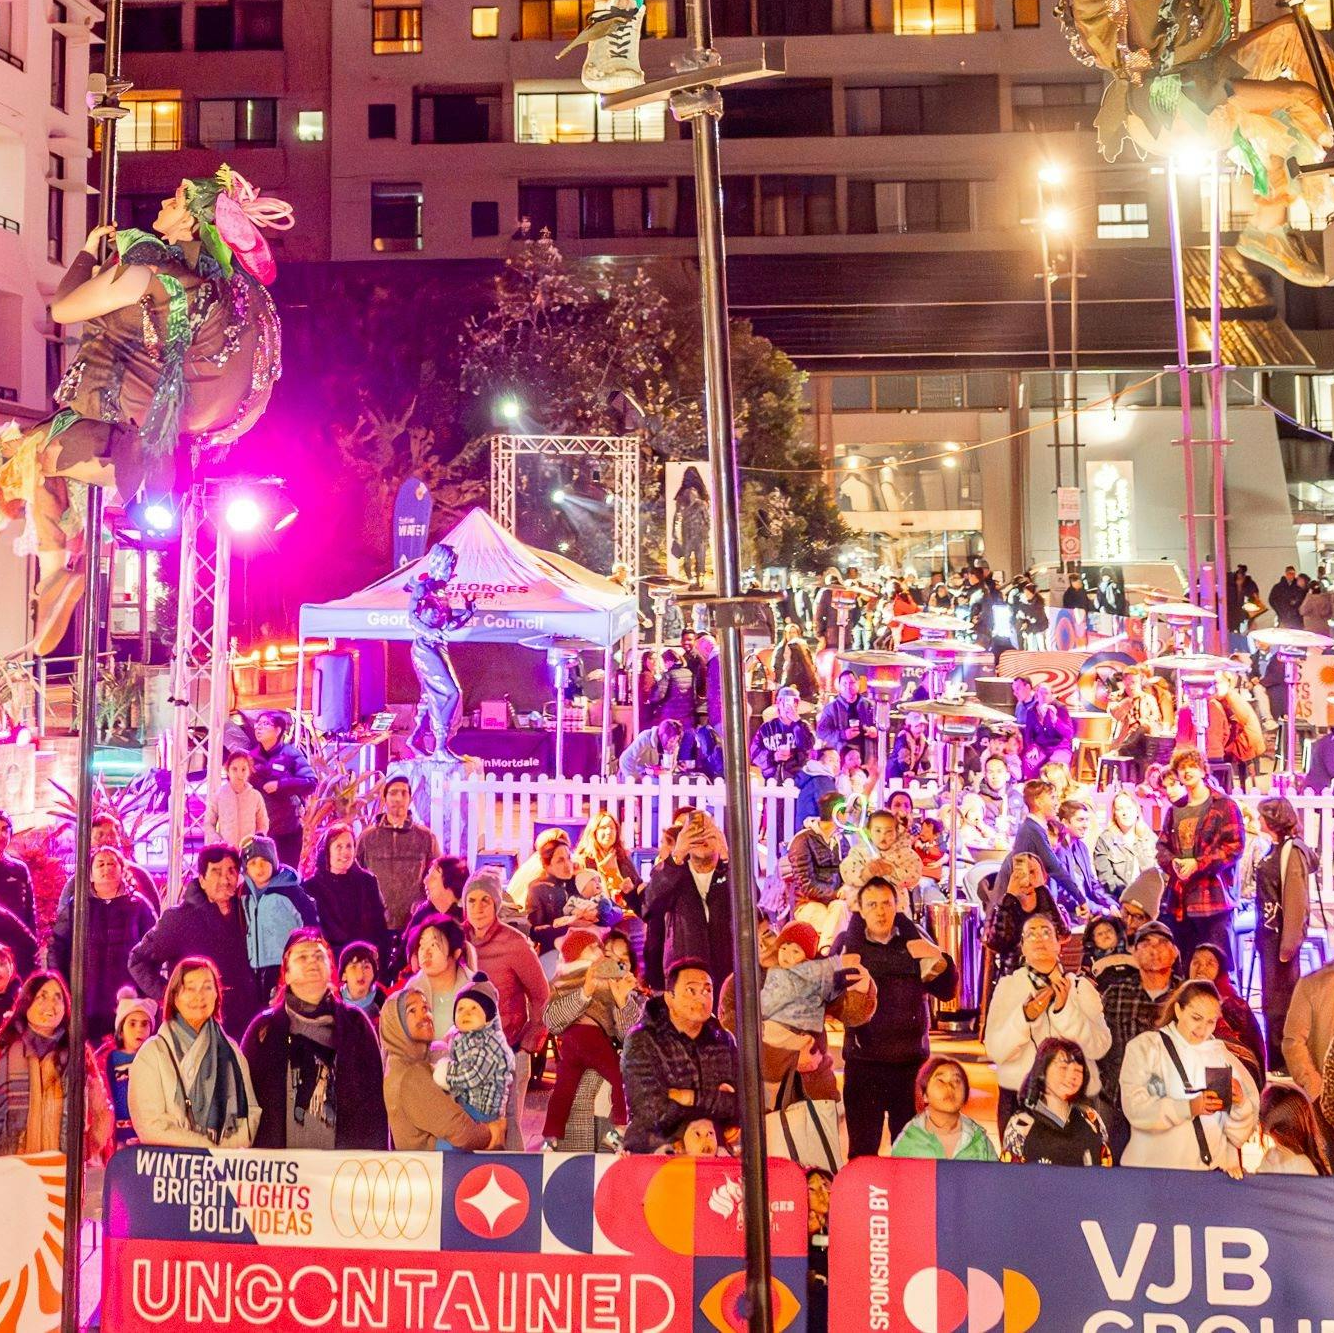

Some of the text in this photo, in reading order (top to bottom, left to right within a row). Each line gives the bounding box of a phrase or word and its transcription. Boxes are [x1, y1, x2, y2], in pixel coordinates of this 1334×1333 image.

[367, 611, 411, 629] Geor
[483, 613, 543, 629] Council
[136, 1149, 299, 1184] WINTER NIGHTS
[153, 1177, 310, 1210] BRIGHT LIGHTS
[189, 1206, 313, 1235] BOLD IDEAS
[869, 1185, 889, 1330] SPONSORED BY
[1080, 1220, 1272, 1306] VJB
[132, 1259, 676, 1333] UNCONTAINED
